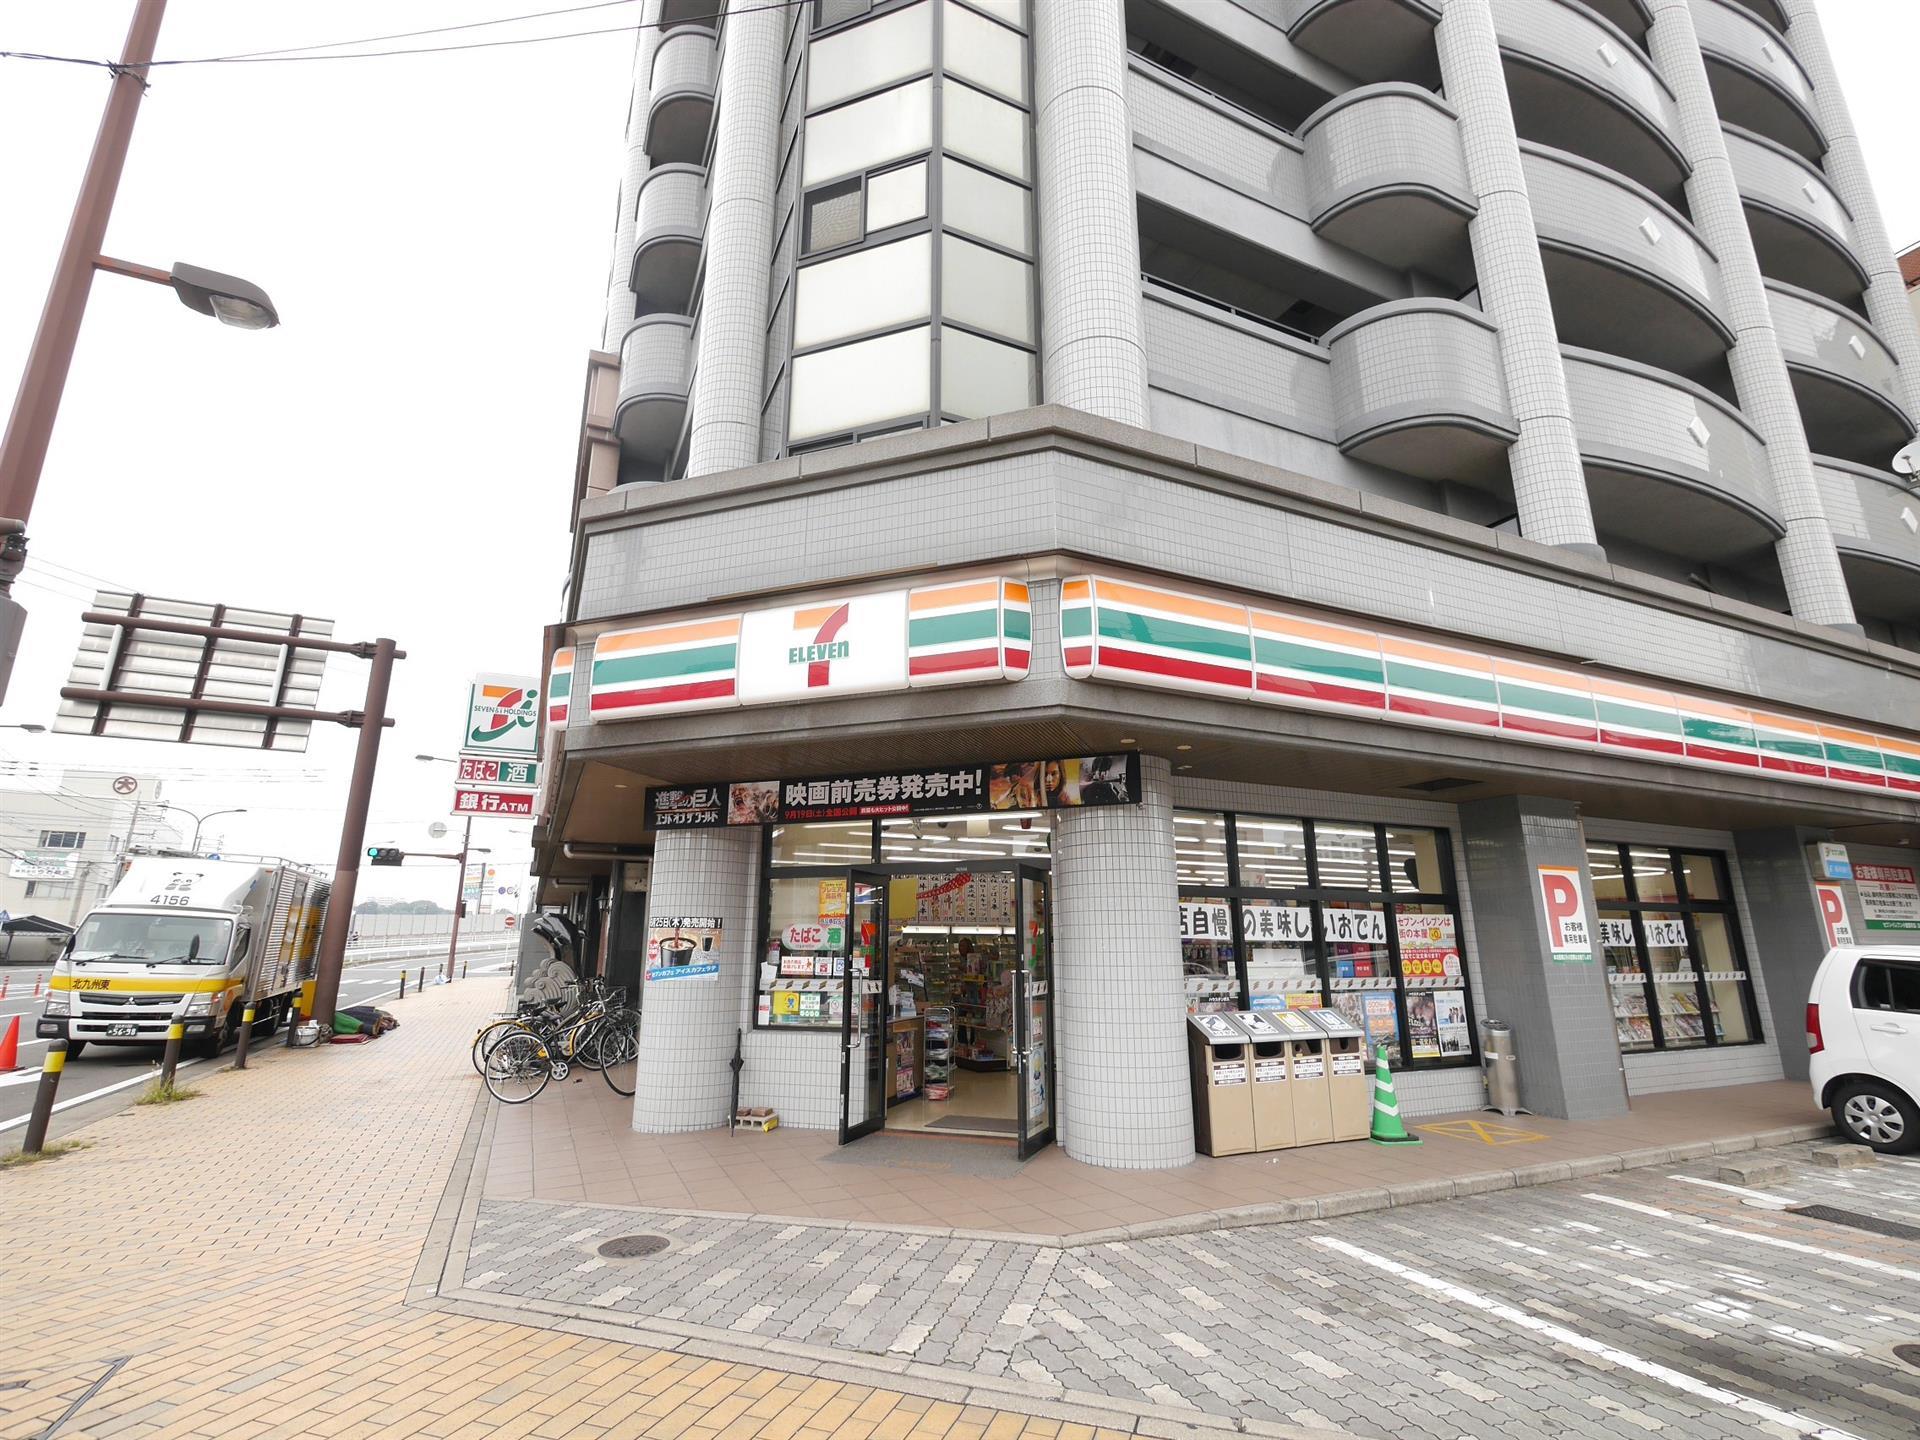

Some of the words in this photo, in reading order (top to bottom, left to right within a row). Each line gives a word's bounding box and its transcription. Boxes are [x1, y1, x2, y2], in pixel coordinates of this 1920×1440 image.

[503, 706, 537, 717] HOLDINGS
[461, 758, 498, 781] たばこ
[506, 762, 528, 783] 酒
[785, 769, 982, 807] 映画前売券発売中!
[459, 792, 529, 813] 銀行ATM
[655, 788, 722, 810] 進撃の巨人
[150, 894, 190, 906] 4156
[1542, 874, 1578, 948] P
[1818, 888, 1843, 948] P
[790, 927, 821, 943] たばこ
[827, 927, 841, 943] 酒
[1564, 921, 1584, 932] お客様
[73, 979, 111, 990] 北九州東
